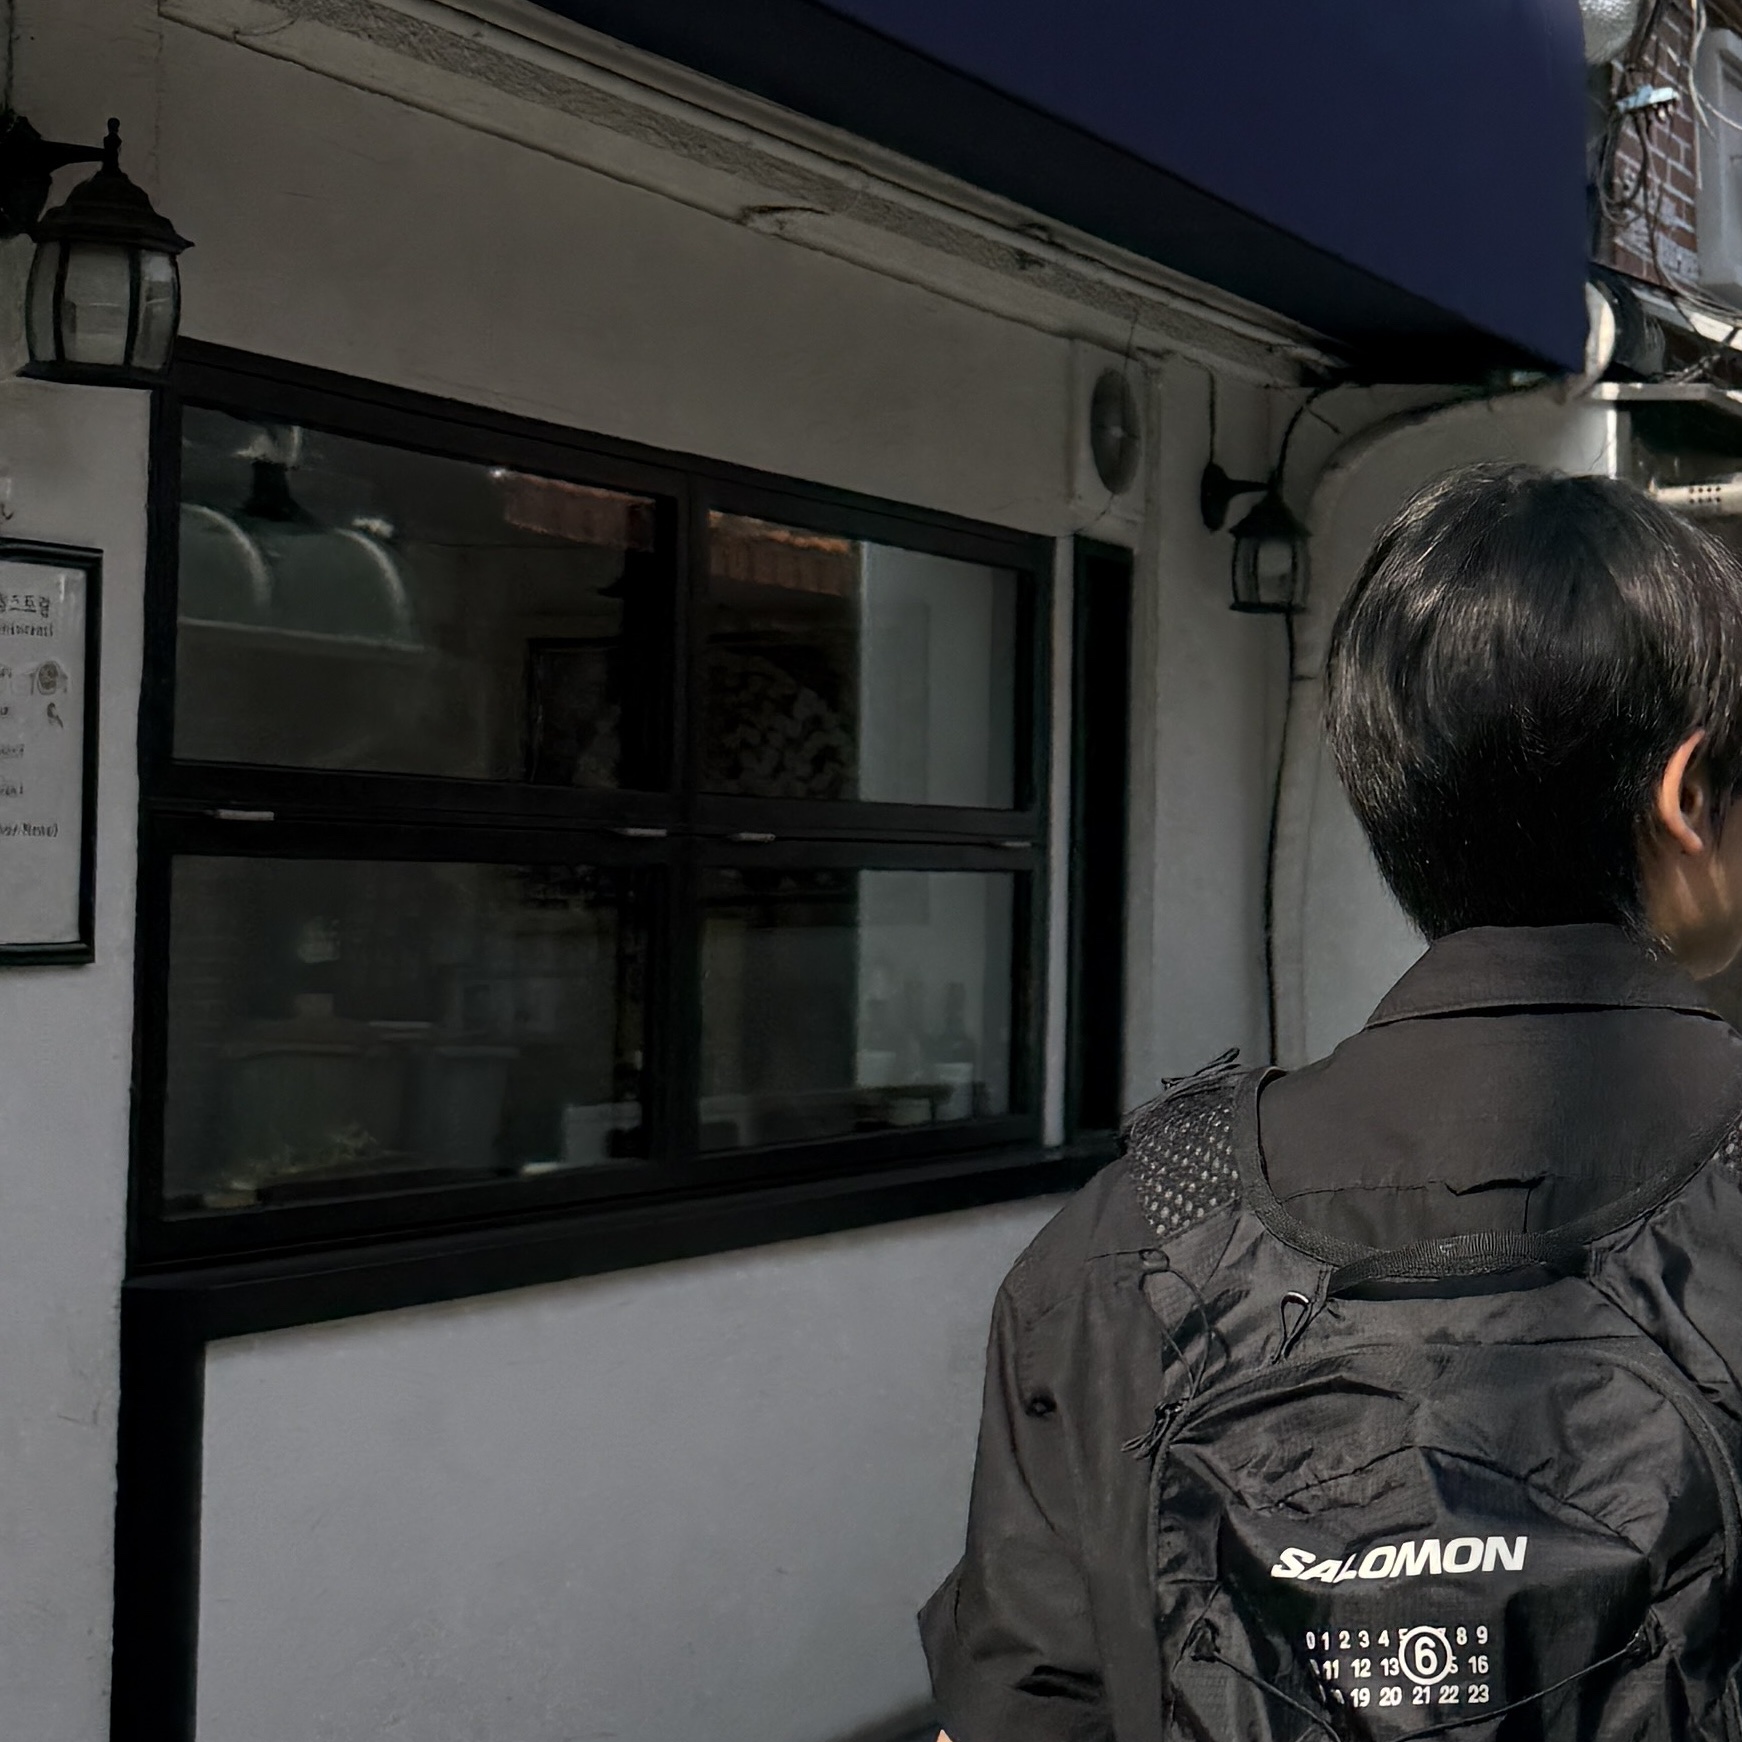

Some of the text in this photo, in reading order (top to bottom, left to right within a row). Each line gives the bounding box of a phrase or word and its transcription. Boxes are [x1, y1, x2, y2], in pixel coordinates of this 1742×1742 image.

[1270, 1536, 1528, 1583] SALOMON
[1306, 1631, 1316, 1650] 0
[1321, 1631, 1330, 1650] 1
[1339, 1630, 1351, 1649] 2
[1358, 1630, 1370, 1648] 3
[1378, 1630, 1389, 1647] 4
[1456, 1626, 1468, 1646] 8
[1476, 1625, 1488, 1645] 9
[1323, 1659, 1340, 1680] 11
[1351, 1658, 1371, 1678] 12
[1380, 1657, 1400, 1677] 13
[1468, 1655, 1489, 1674] 16
[1414, 1636, 1438, 1675] 6
[1350, 1684, 1490, 1708] 19 20 21 22 23
